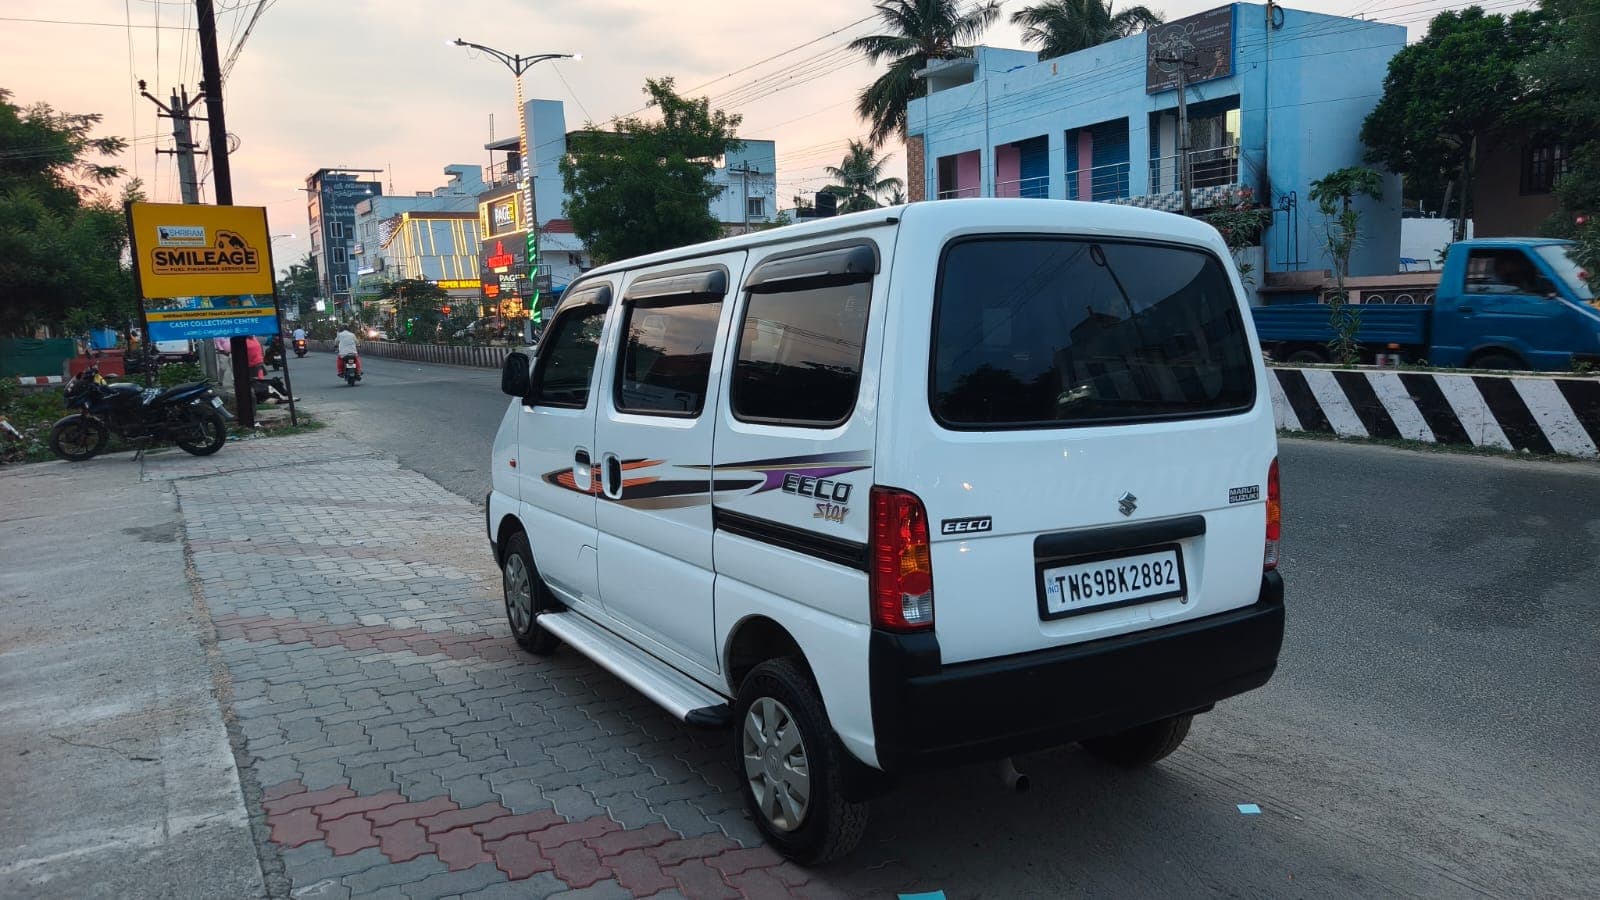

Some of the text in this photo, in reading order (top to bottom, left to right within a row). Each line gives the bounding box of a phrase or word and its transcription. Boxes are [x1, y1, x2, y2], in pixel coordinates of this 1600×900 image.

[169, 229, 203, 237] SHRIRAM
[155, 251, 256, 266] SMILEAGE
[191, 319, 233, 327] COLLECTION
[233, 317, 260, 325] CENTRE
[782, 473, 853, 504] EECO
[1230, 486, 1259, 495] MARUTI
[1230, 493, 1259, 502] SUZUKI
[943, 519, 990, 533] EECO
[1055, 559, 1175, 604] TN69BK2882
